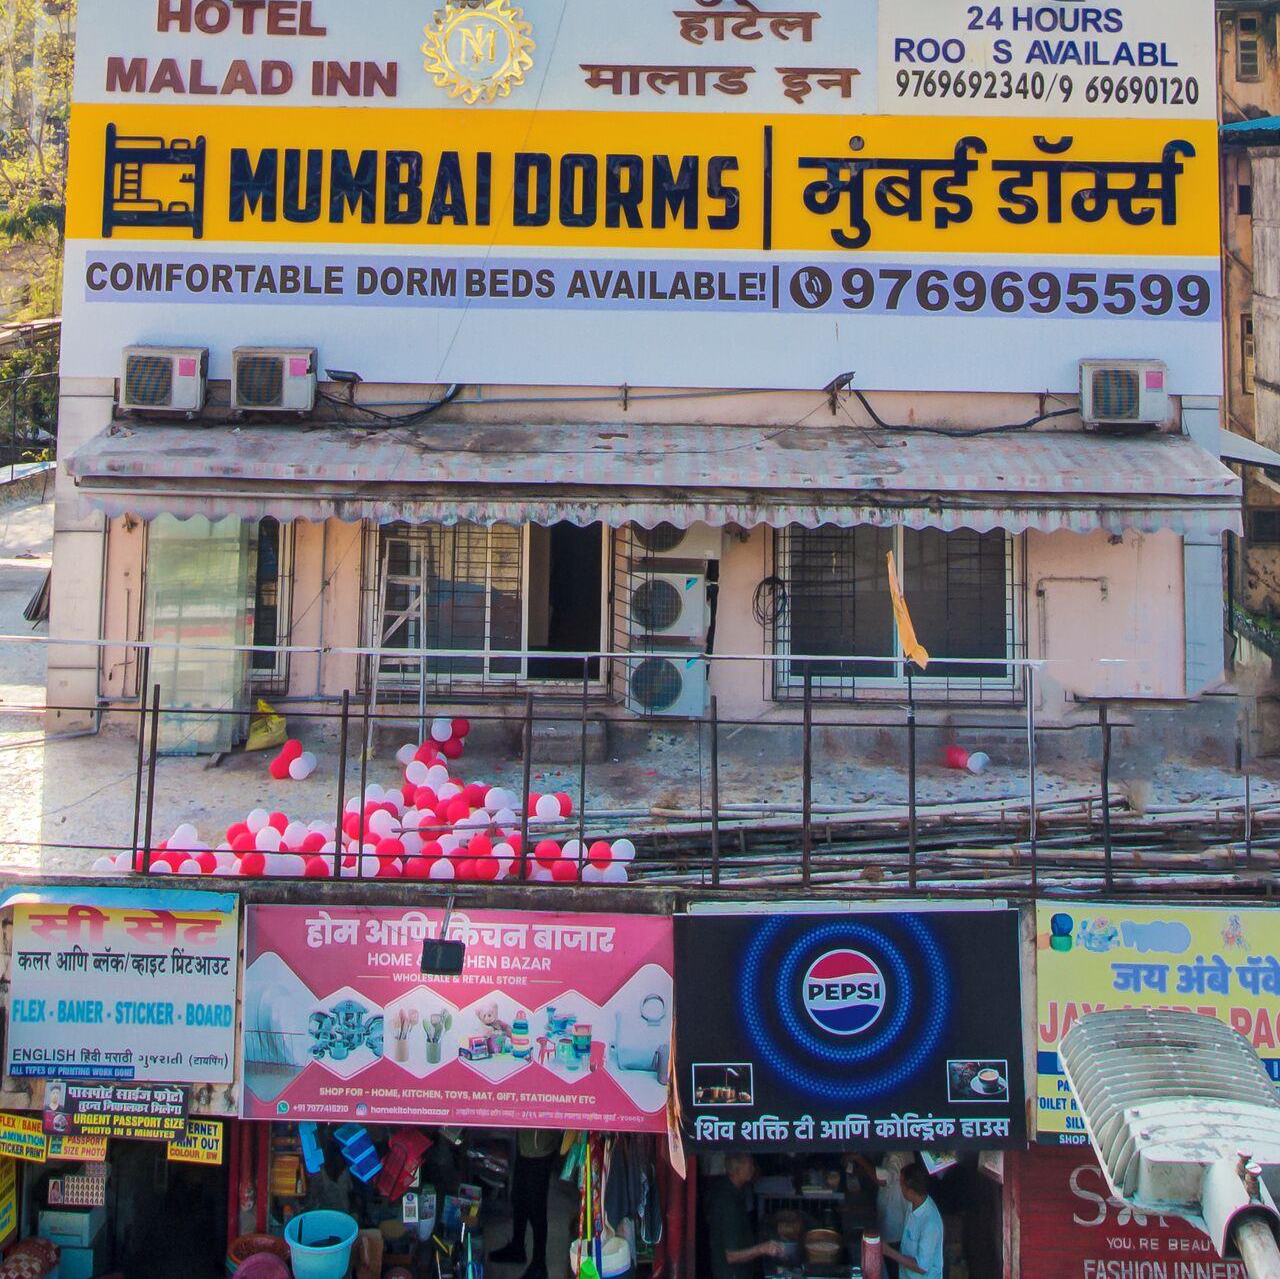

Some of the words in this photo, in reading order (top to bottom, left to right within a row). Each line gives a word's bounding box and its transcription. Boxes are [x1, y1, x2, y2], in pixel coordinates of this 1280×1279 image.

[967, 6, 1003, 31] 24
[1013, 7, 1123, 33] HOURS
[106, 56, 293, 96] MALAD
[312, 61, 398, 97] INN
[579, 64, 756, 95] मालाड
[775, 67, 861, 104] इन
[228, 147, 492, 226] MUMBAI
[513, 152, 739, 230] DORMS
[797, 135, 988, 249] मुंबई
[85, 261, 345, 296] COMFORTABLE
[356, 266, 457, 297] DORM
[465, 268, 556, 299] BEDS
[565, 268, 766, 302] AVAILABLE!
[841, 269, 1211, 317] 9769695599
[306, 911, 359, 948] होम
[365, 912, 437, 946] आणि
[532, 922, 616, 953] बाजार
[18, 951, 51, 971] कलर
[57, 945, 89, 972] आणि
[367, 952, 412, 967] HOME
[501, 956, 551, 970] BAZAR
[393, 973, 451, 984] WHOLESALE
[453, 974, 460, 983] &
[463, 974, 494, 984] RETAIL
[496, 975, 527, 985] STORE
[1111, 962, 1170, 994] जय
[1176, 954, 1232, 996] अंबे
[808, 982, 881, 1001] PEPSI
[12, 999, 46, 1023] FLEX
[58, 1001, 104, 1025] BANER
[115, 1003, 174, 1026] STICKER
[186, 1004, 232, 1028] BOARD
[12, 1048, 76, 1062] ENGLISH
[105, 1049, 132, 1064] मराठी
[11, 1066, 24, 1075] ALL
[25, 1066, 46, 1076] TYPES
[92, 1068, 113, 1077] WORK
[114, 1068, 134, 1077] DONE
[320, 1086, 343, 1098] SHOP
[344, 1087, 363, 1098] FOR
[371, 1088, 401, 1100] HOME,
[402, 1089, 443, 1101] KITCHEN,
[445, 1090, 470, 1102] TOYS,
[471, 1091, 495, 1102] MAT,
[496, 1092, 518, 1103] GIFT,
[520, 1093, 577, 1105] STATIONARY
[579, 1094, 596, 1105] ETC
[1037, 1097, 1067, 1110] OILET
[370, 1105, 449, 1115] homekitchenbazaar
[0, 1115, 16, 1130] FLEX
[73, 1113, 111, 1125] URGENT
[113, 1115, 161, 1128] PASSPORT
[163, 1118, 185, 1129] SIZE
[694, 1115, 735, 1140] शिव
[740, 1114, 789, 1140] शक्ति
[792, 1114, 815, 1139] टी
[820, 1113, 870, 1140] आणि
[959, 1118, 1010, 1137] हाउस
[67, 1135, 105, 1146] PASSPORT
[81, 1126, 111, 1135] PHOTO
[114, 1127, 124, 1135] IN
[126, 1128, 132, 1136] 5
[134, 1128, 175, 1139] MINUTES
[1059, 1134, 1086, 1145] SHOP
[63, 1145, 79, 1155] SIZE
[81, 1147, 106, 1157] PHOTO
[201, 1137, 220, 1150] OUT
[25, 1147, 44, 1159] PRINT
[169, 1148, 200, 1160] COLOUR
[1083, 1259, 1166, 1279] FASHION
